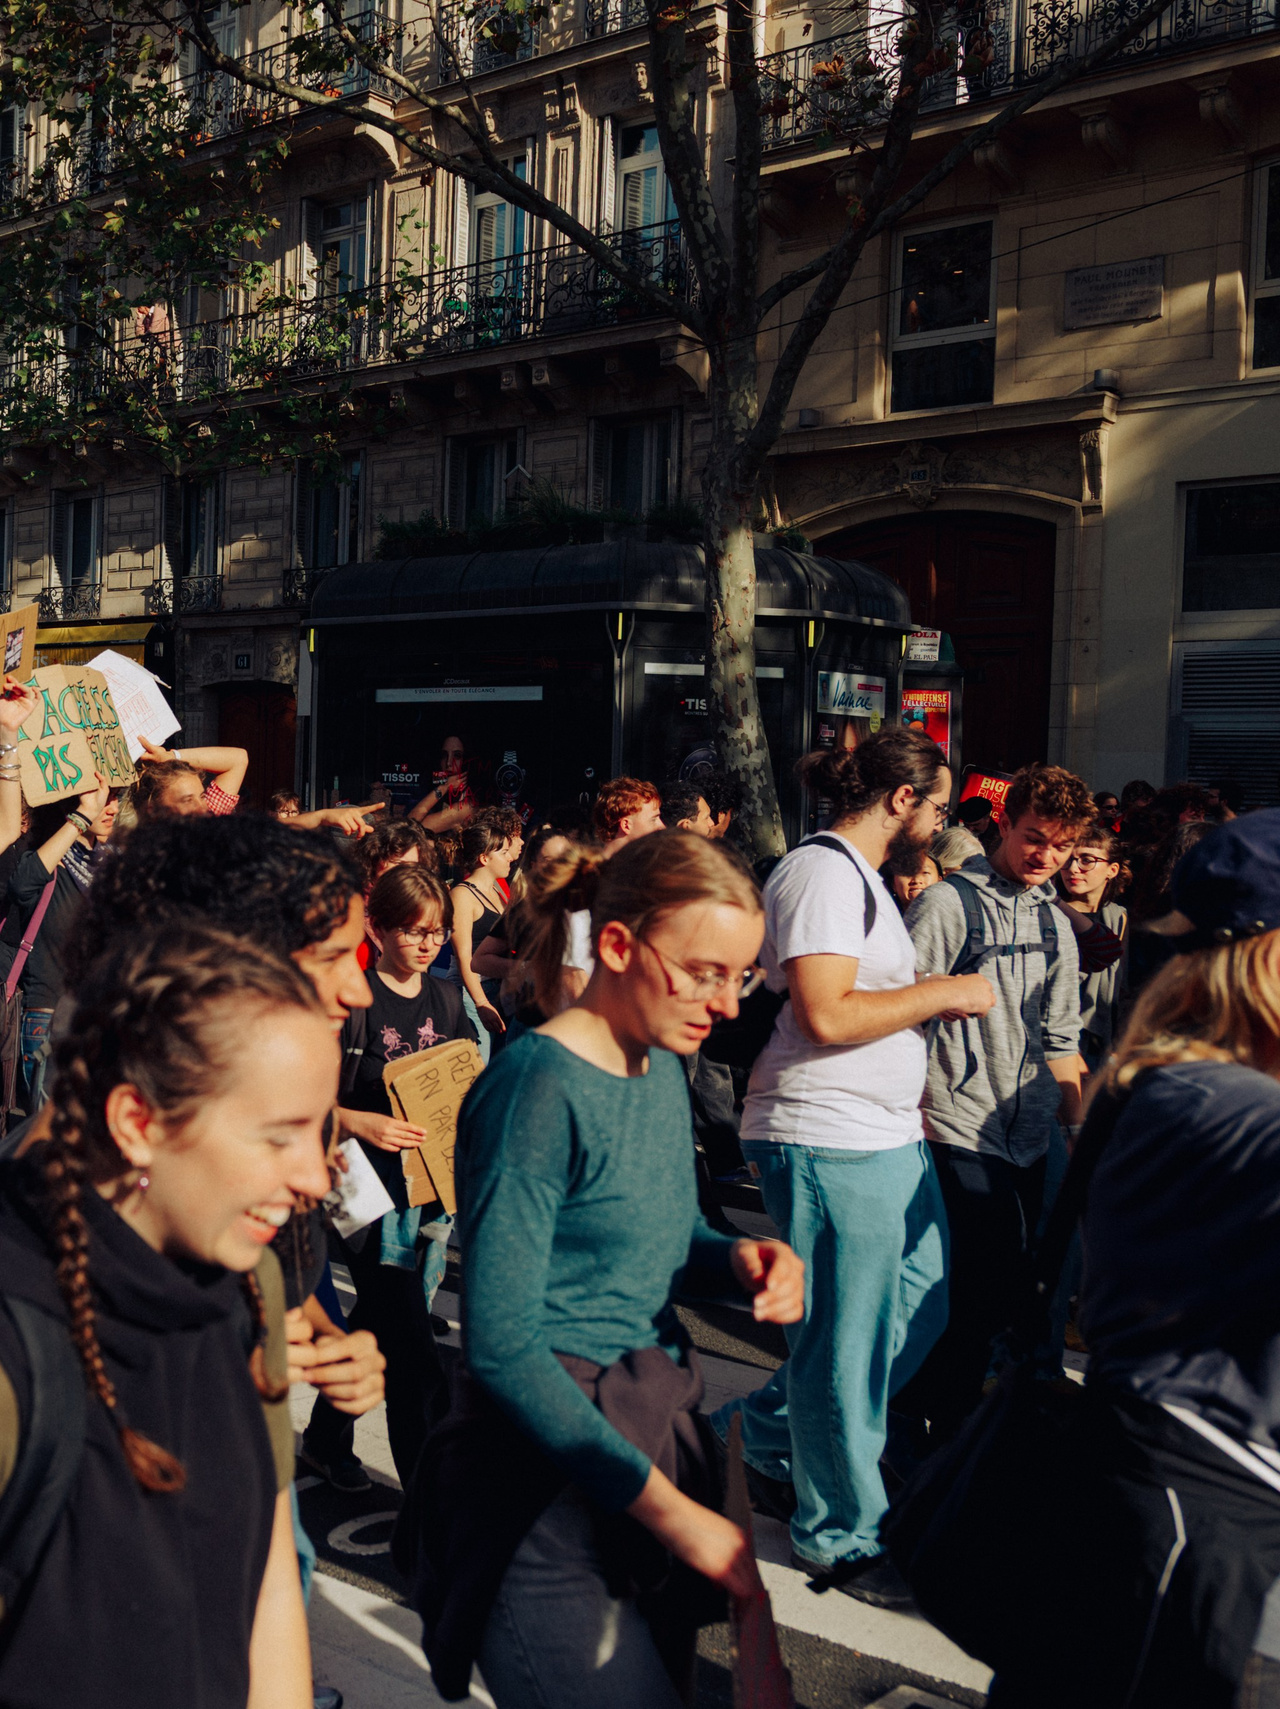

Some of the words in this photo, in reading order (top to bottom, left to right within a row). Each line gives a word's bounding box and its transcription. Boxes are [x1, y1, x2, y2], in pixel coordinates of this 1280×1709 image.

[237, 656, 247, 667] 61
[32, 743, 82, 792] PAS
[381, 772, 420, 782] TISSOT
[980, 777, 1005, 792] BIG
[977, 788, 1001, 803] BUS
[415, 1067, 443, 1101] RN
[428, 1105, 457, 1141] PAR
